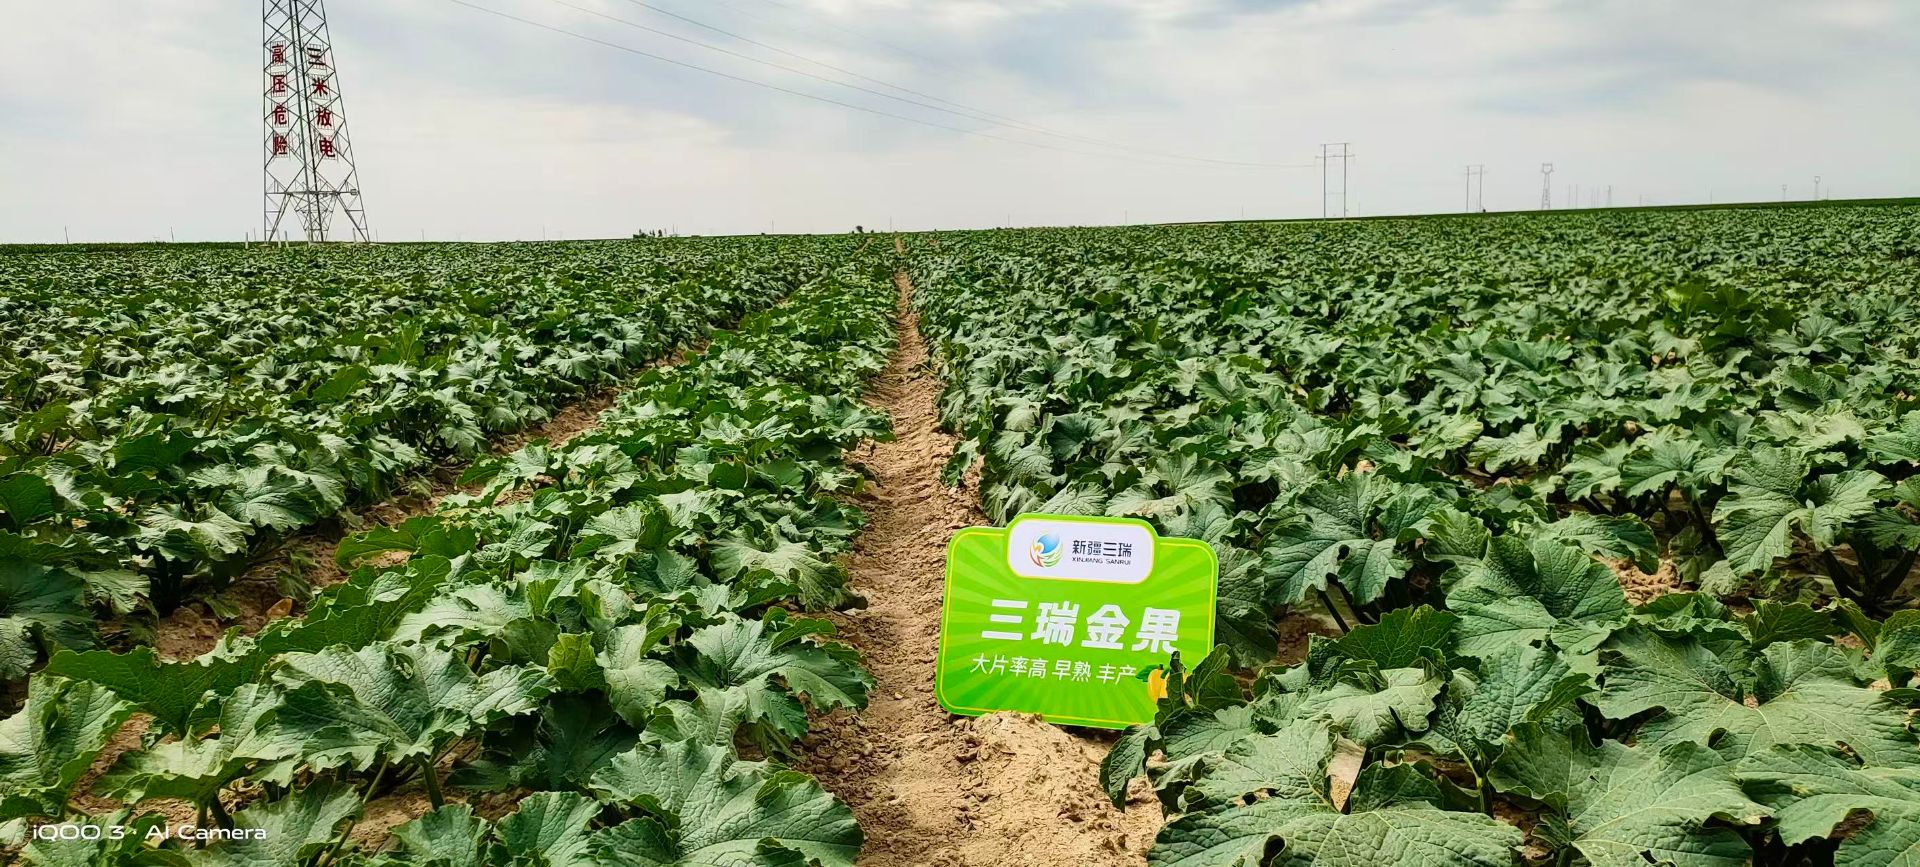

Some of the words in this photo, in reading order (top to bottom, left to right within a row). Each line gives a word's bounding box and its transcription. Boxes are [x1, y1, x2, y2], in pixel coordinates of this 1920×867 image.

[271, 43, 288, 155] 高压危险
[307, 47, 336, 158] 三米放电
[1072, 539, 1132, 558] 新疆三瑞
[1072, 556, 1104, 564] XINJIANG
[1105, 558, 1132, 566] SANRUI
[981, 598, 1181, 655] 三瑞金果
[970, 653, 1049, 679] 大片率高
[1052, 660, 1093, 683] 早熟
[1096, 663, 1137, 685] 丰产
